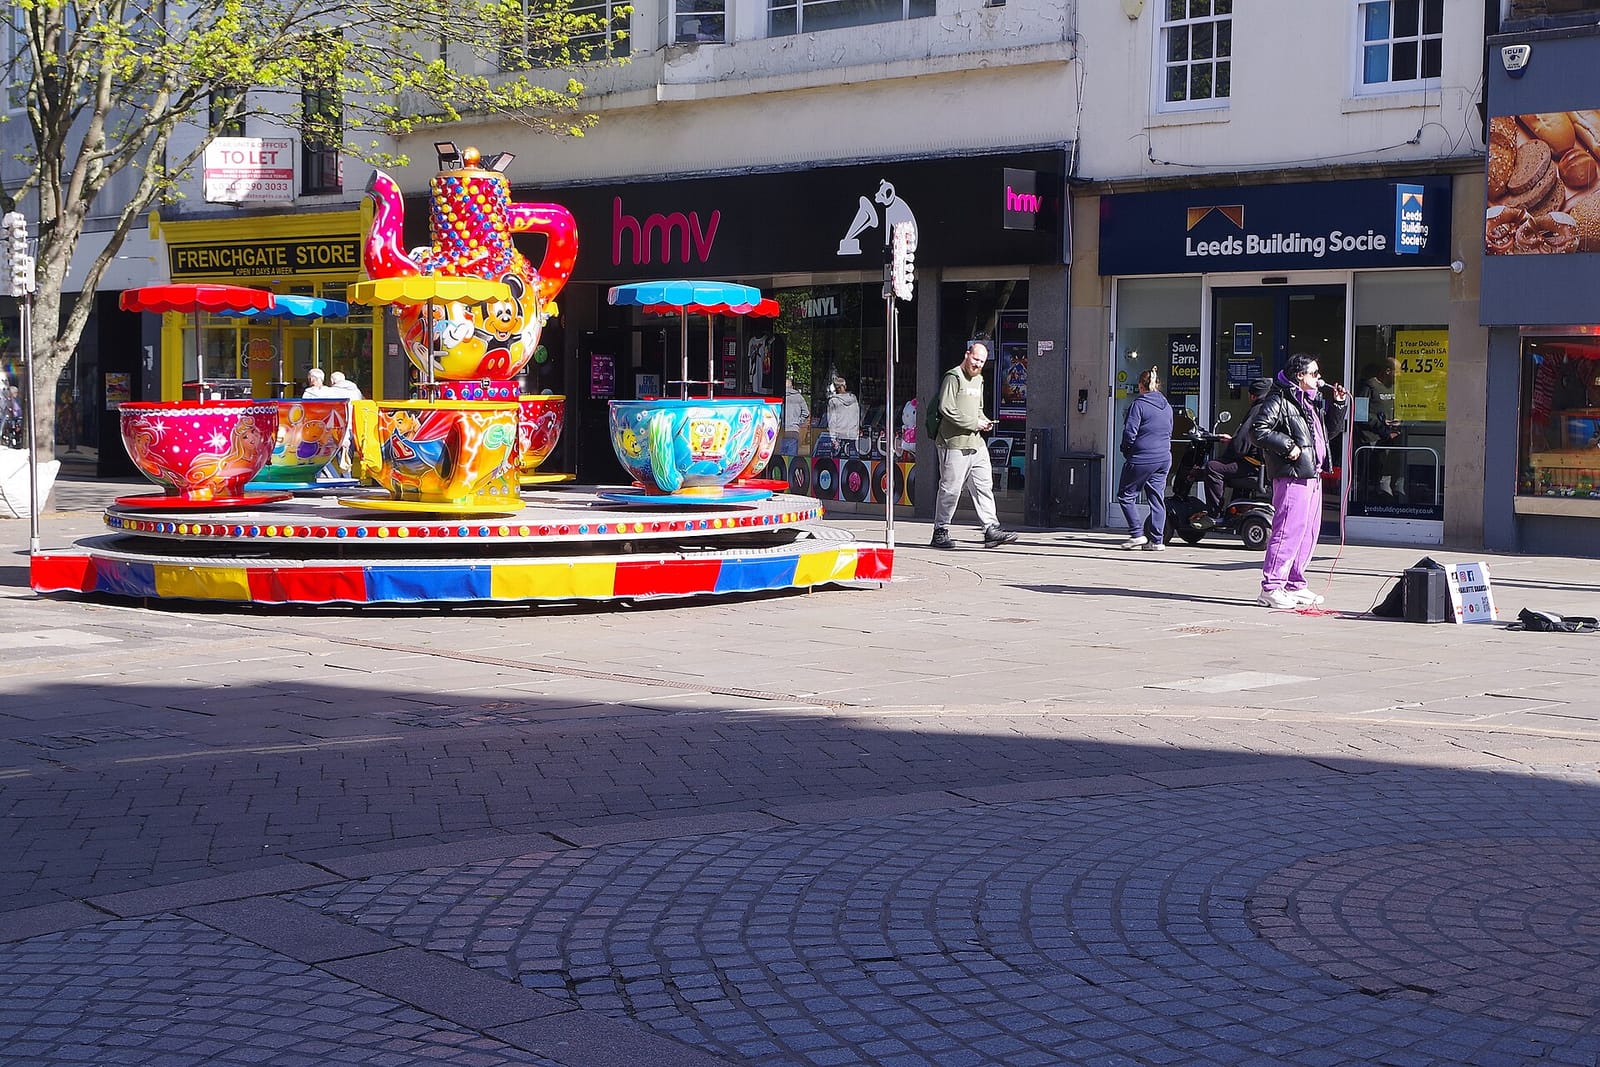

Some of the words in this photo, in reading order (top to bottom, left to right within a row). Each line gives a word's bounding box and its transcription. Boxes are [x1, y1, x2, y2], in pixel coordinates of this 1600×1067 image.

[220, 150, 245, 165] TO
[249, 150, 279, 165] LET
[265, 183, 288, 191] 3033
[1007, 185, 1043, 213] hmv
[1401, 209, 1422, 221] Leeds
[612, 196, 721, 266] hmv
[1401, 221, 1429, 236] Building
[1186, 235, 1243, 257] Leeds
[1246, 232, 1326, 258] Building
[1400, 233, 1427, 248] Society
[177, 247, 288, 268] FRENCHGATE
[296, 244, 356, 264] STORE
[236, 267, 251, 276] OPEN
[255, 267, 270, 275] DAYS
[276, 266, 293, 275] WEEK
[800, 296, 838, 318] VINYL
[1172, 341, 1199, 353] Save.
[1172, 353, 1198, 365] Earn.
[1401, 358, 1444, 373] 4.35%
